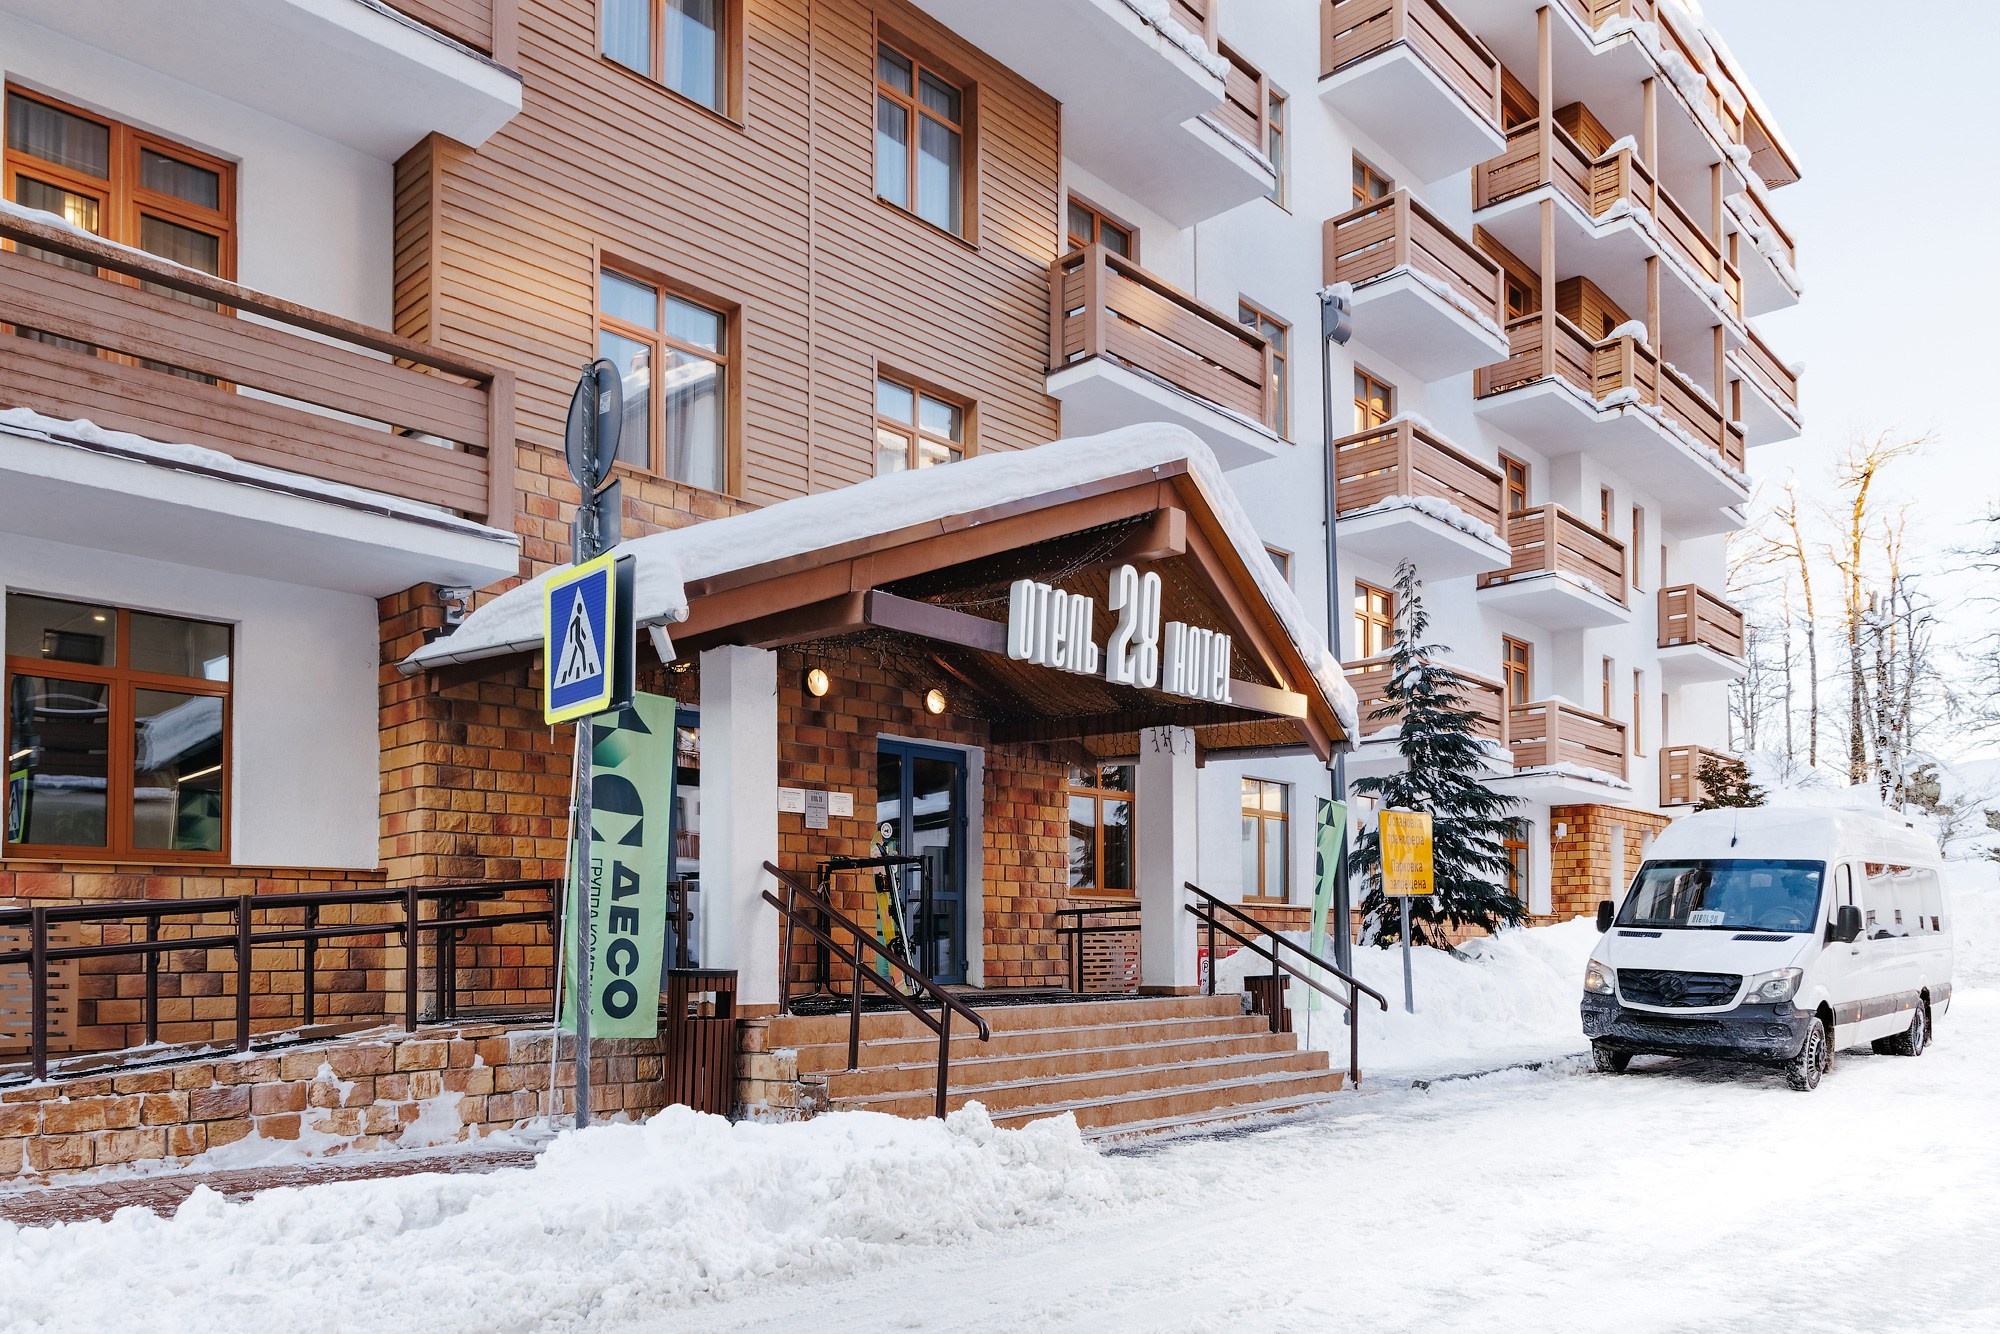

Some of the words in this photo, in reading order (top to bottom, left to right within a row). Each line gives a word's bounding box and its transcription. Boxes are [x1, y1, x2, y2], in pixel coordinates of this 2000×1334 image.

[1106, 564, 1161, 689] 28
[1392, 859, 1422, 874] Парковка
[602, 860, 640, 1020] ДЕСО
